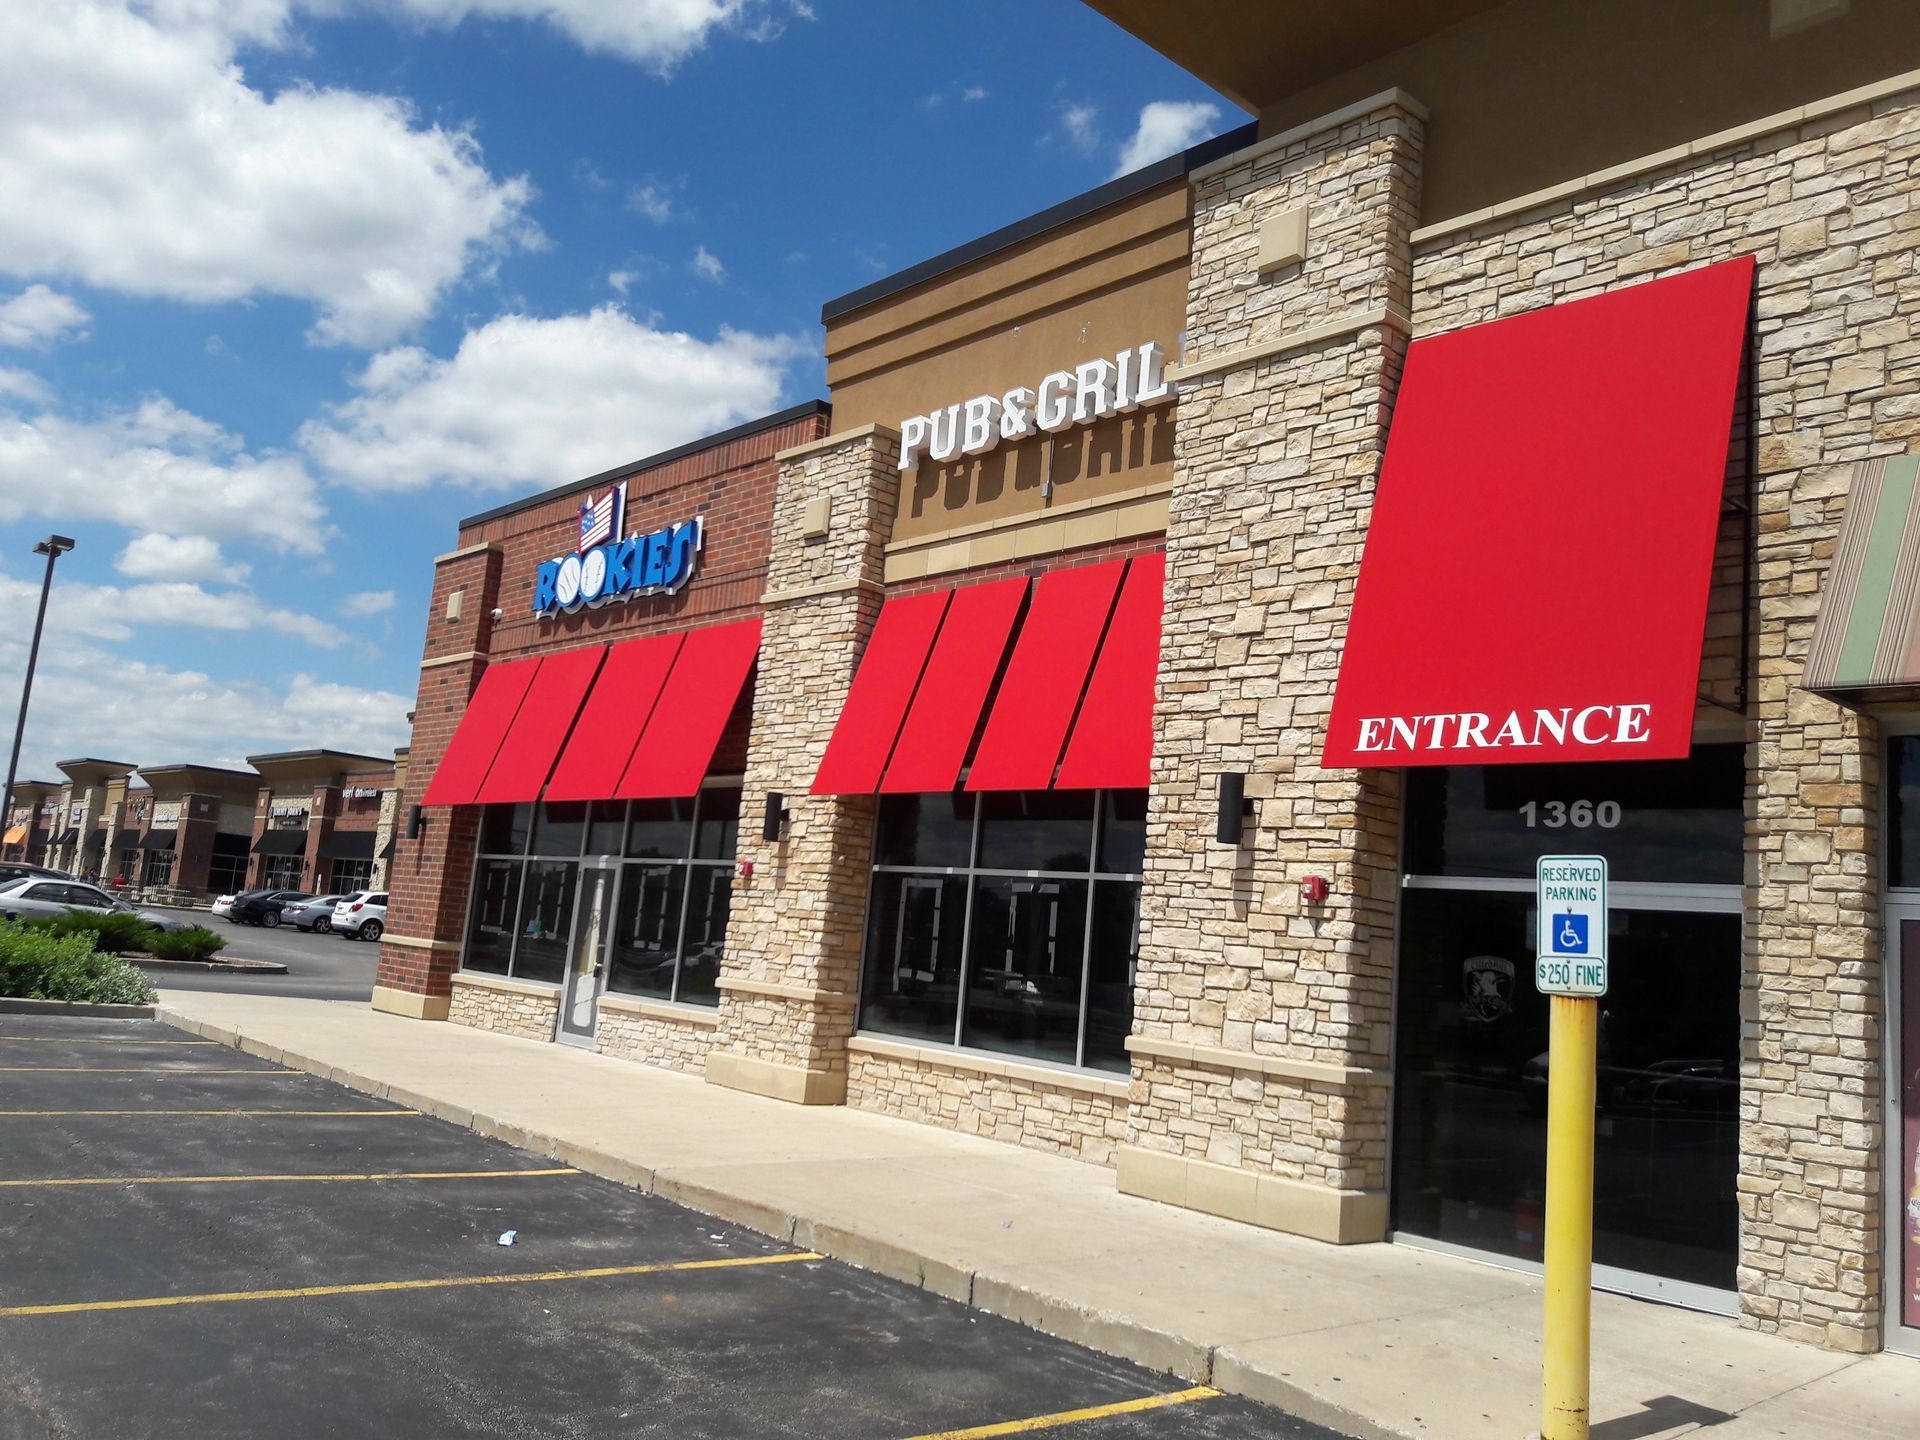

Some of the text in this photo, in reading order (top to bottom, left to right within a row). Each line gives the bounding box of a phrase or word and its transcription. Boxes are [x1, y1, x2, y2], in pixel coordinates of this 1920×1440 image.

[531, 517, 701, 615] ROOKIES
[1353, 703, 1651, 752] ENTRANCE
[1518, 800, 1622, 828] 1360
[1542, 867, 1601, 882] RESERVED
[1546, 887, 1597, 902] PARKING
[1539, 964, 1570, 985] $250
[1576, 965, 1603, 986] FINE
